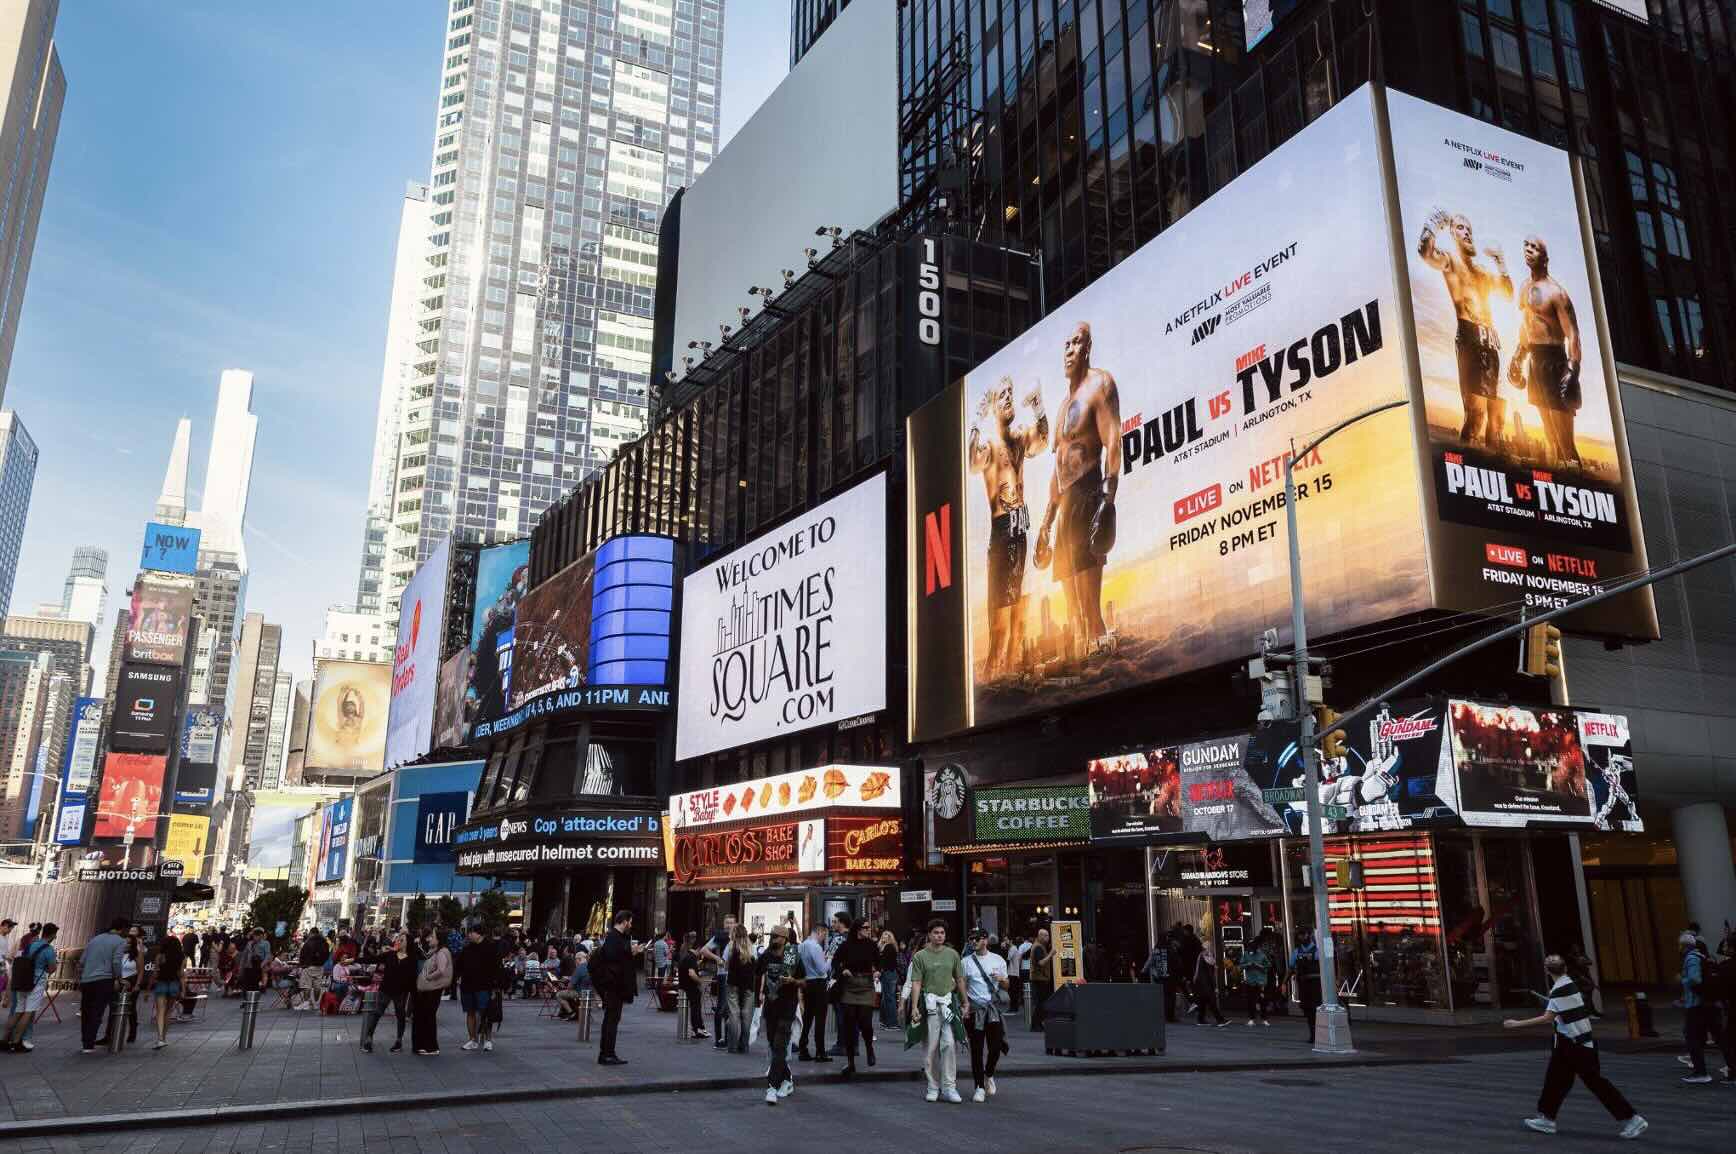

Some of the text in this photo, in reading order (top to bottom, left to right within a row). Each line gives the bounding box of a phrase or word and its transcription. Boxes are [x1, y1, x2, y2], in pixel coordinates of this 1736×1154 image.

[1444, 138, 1525, 172] A NETFLIX LIVE EVENT
[919, 239, 940, 345] 1500
[1165, 241, 1298, 335] A NETFLIX LIVE EVENT
[1235, 344, 1266, 370] MIKE
[1121, 298, 1384, 476] PAUL VS TYSON
[1173, 390, 1313, 464] AT&T STADIUM ARLINGTON, TX
[1188, 490, 1218, 514] LIVE
[1228, 480, 1243, 494] ON
[1445, 462, 1617, 524] PAUL VS TYSON
[1169, 473, 1333, 550] FRIDAY NOVEMBR 15
[1487, 503, 1504, 514] AT&T
[1505, 505, 1535, 518] STADIUM
[1582, 519, 1593, 529] TX
[155, 533, 190, 551] NOW
[926, 503, 952, 597] N
[1219, 520, 1278, 556] 8 PM ET
[715, 516, 836, 593] WELCOME TO
[1498, 549, 1598, 578] LIVE ON NETFLIX
[1482, 568, 1524, 586] FRIDAY
[1526, 574, 1591, 596] NOVEMBER
[760, 566, 835, 636] TIMES
[1525, 593, 1533, 606] 8
[1553, 598, 1568, 609] ET
[129, 631, 184, 648] PASSENGER
[128, 671, 173, 682] SAMSUNG
[710, 615, 835, 728] SQUARE
[538, 700, 545, 715] 5,
[547, 696, 555, 713] 6,
[556, 692, 582, 709] AND
[586, 688, 629, 705] 11PM
[777, 686, 834, 726] .COM
[1584, 721, 1619, 737] NETFLIX
[1183, 743, 1239, 766] GUNDAM
[689, 790, 720, 809] STYLE
[977, 796, 1089, 813] STARBUCKS
[1193, 804, 1234, 816] OCTOBER 17
[1328, 807, 1338, 818] 43
[425, 812, 457, 844] GAP
[509, 821, 528, 834] NEWS
[535, 818, 557, 836] Cop
[561, 816, 643, 832] 'attacked'
[648, 816, 660, 832] b
[766, 824, 794, 842] BAKE
[997, 815, 1070, 830] COFFEE
[845, 820, 899, 855] CARLO'S
[495, 845, 539, 863] unsecured
[542, 844, 593, 861] helmet
[597, 843, 660, 860] comms
[765, 844, 794, 861] SHOP
[846, 858, 900, 870] BAKE SHOP
[99, 870, 154, 881] HOTDOGS
[1229, 870, 1249, 879] STORE
